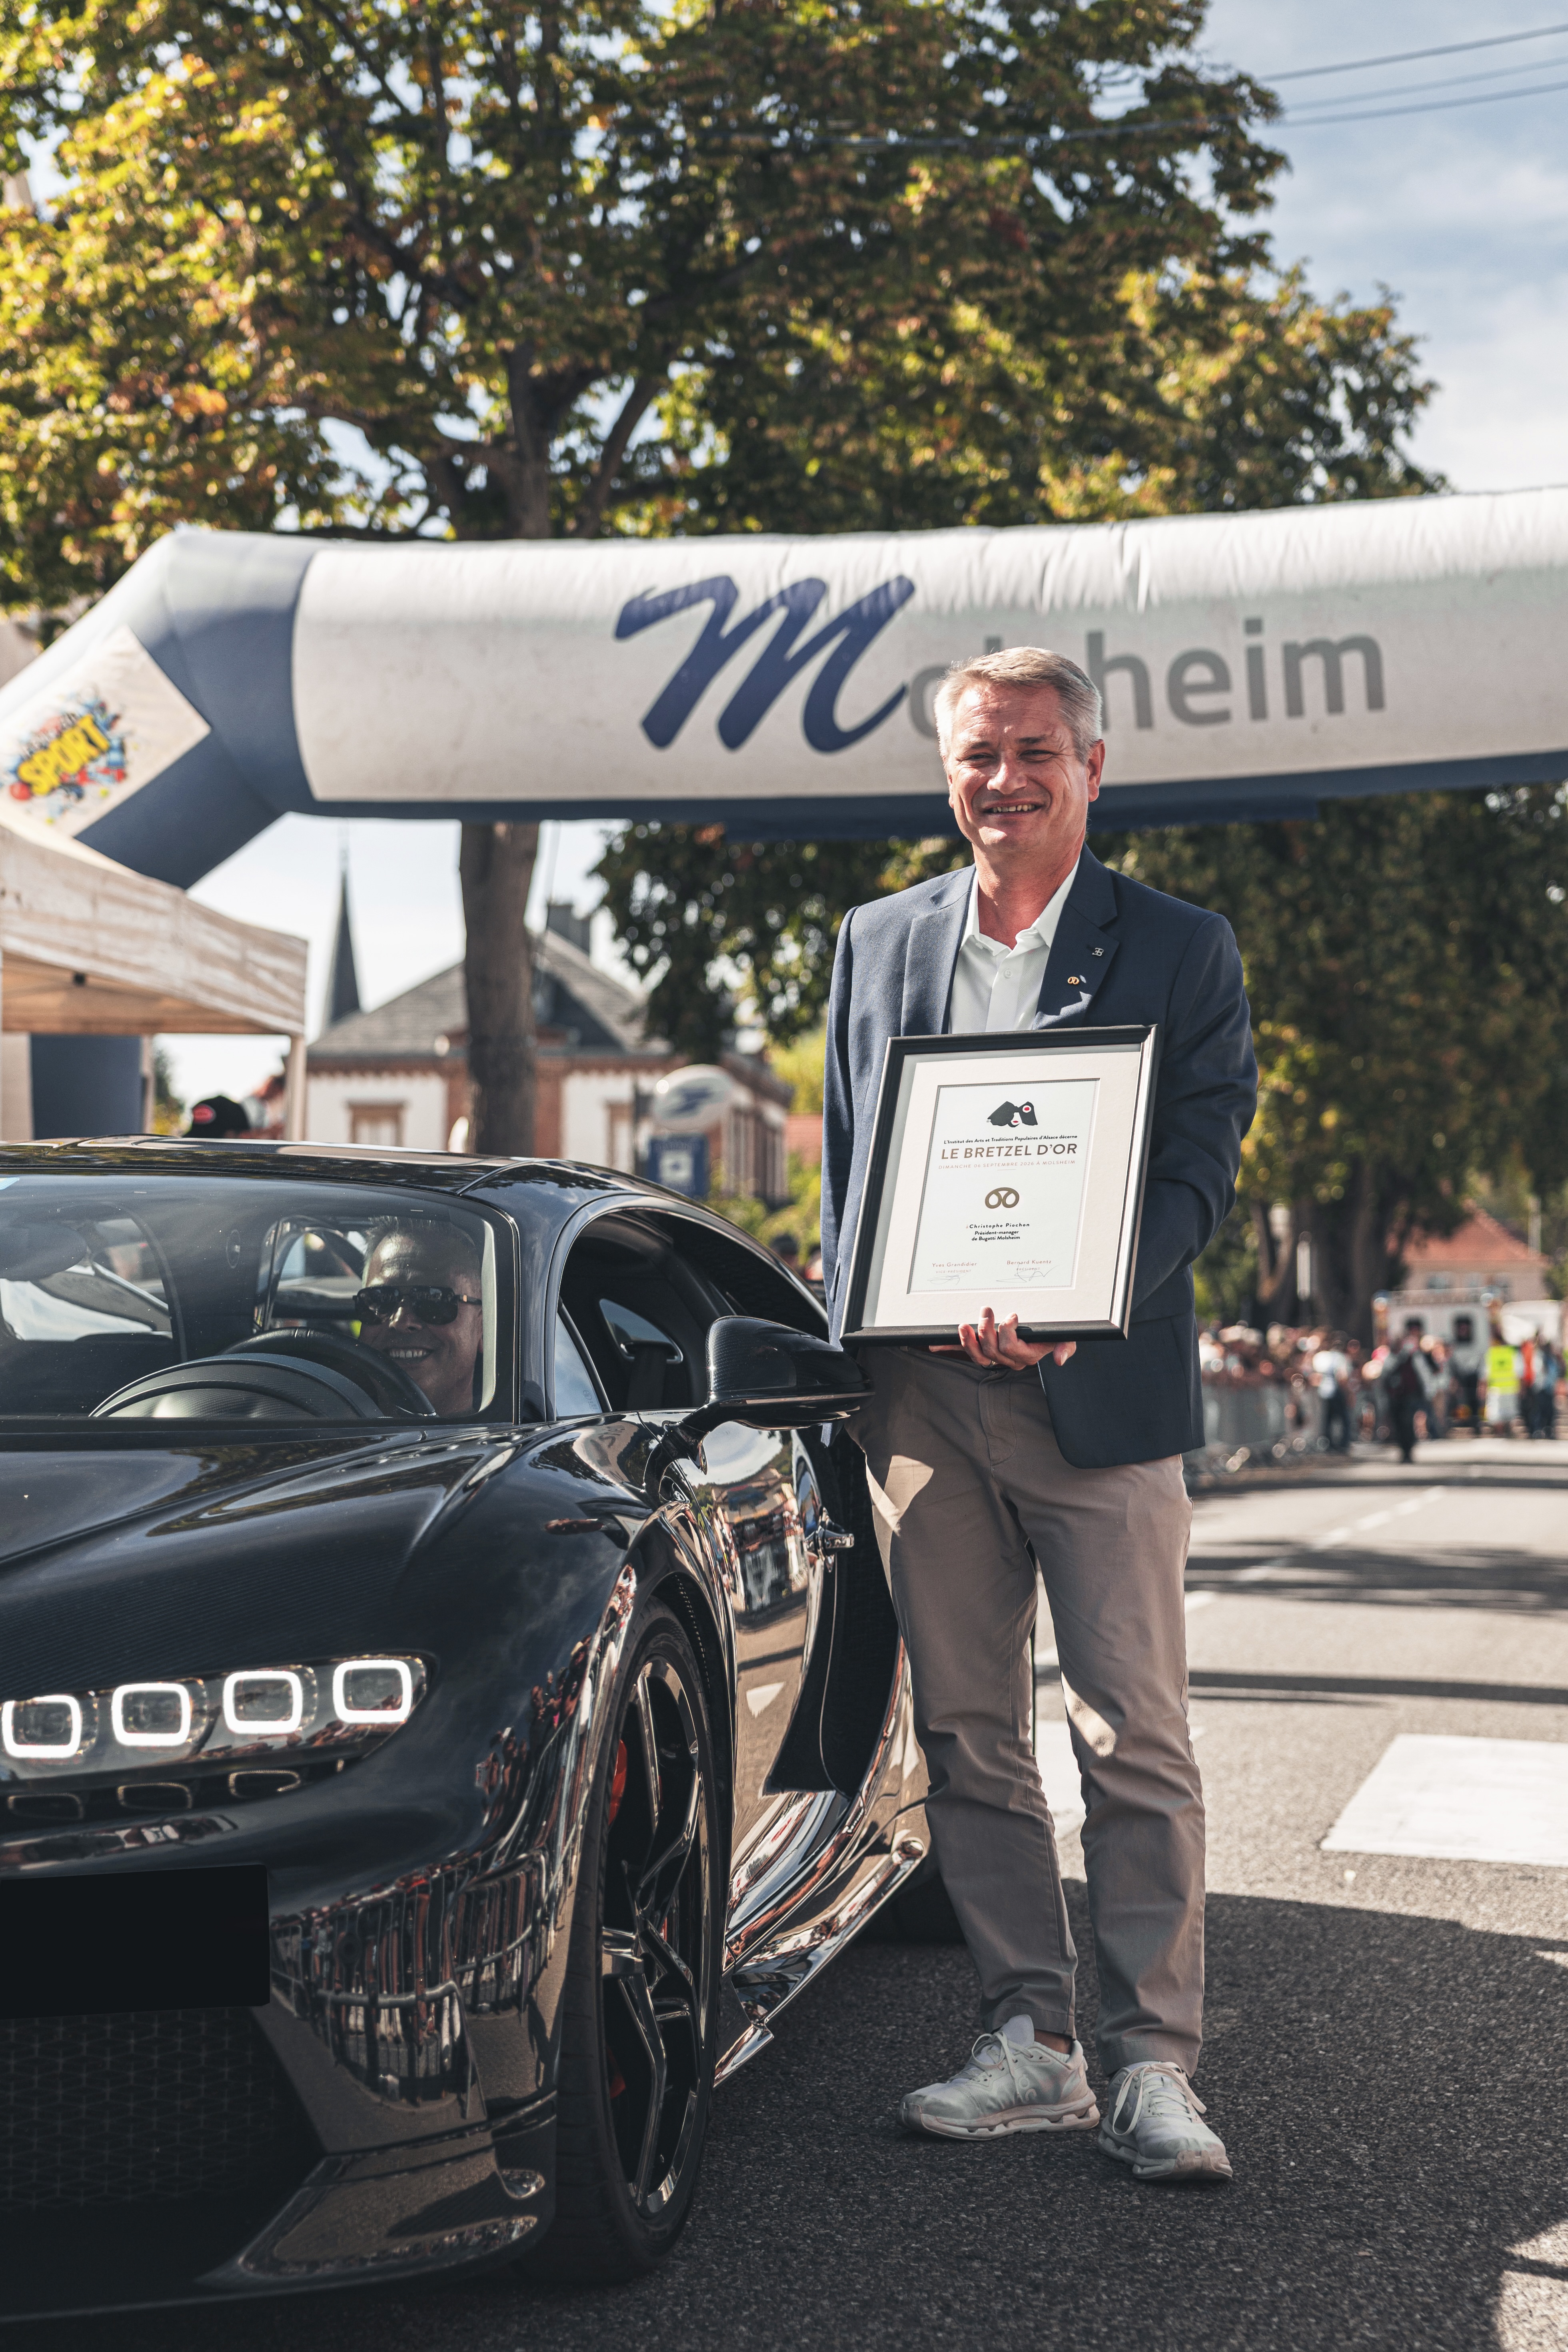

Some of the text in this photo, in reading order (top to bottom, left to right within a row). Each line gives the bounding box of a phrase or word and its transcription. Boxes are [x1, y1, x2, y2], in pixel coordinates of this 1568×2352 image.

[614, 574, 1385, 753] Mheim
[18, 714, 109, 795] SPORT
[941, 1143, 1077, 1159] LE BRETZEL D'OR
